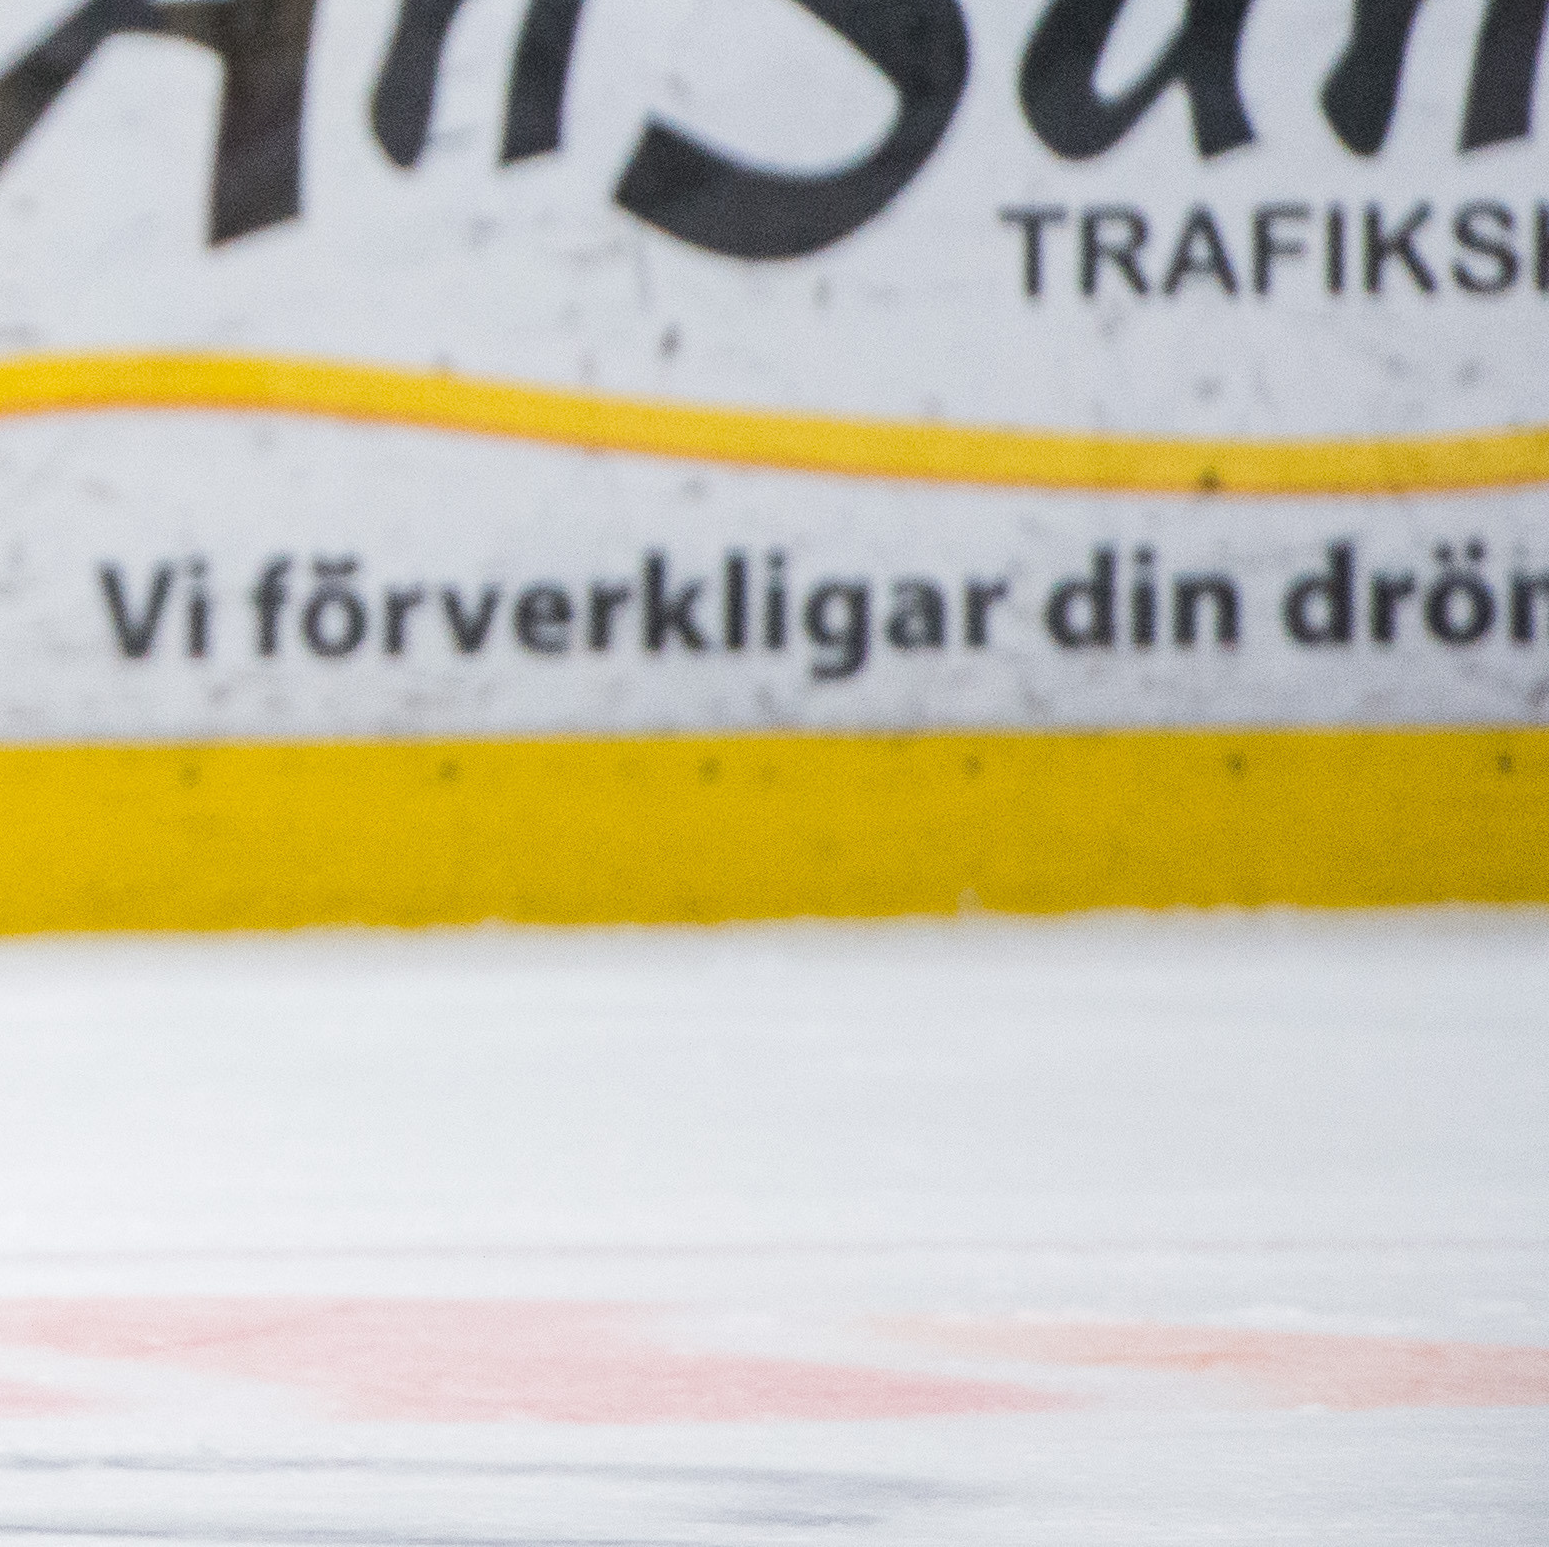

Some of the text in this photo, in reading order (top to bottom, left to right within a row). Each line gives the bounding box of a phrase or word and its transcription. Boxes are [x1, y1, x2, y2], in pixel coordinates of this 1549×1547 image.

[998, 202, 1549, 297] TRAFIKS
[95, 558, 212, 657] Vi
[249, 549, 1011, 682] förverkligar
[1043, 544, 1243, 650] din
